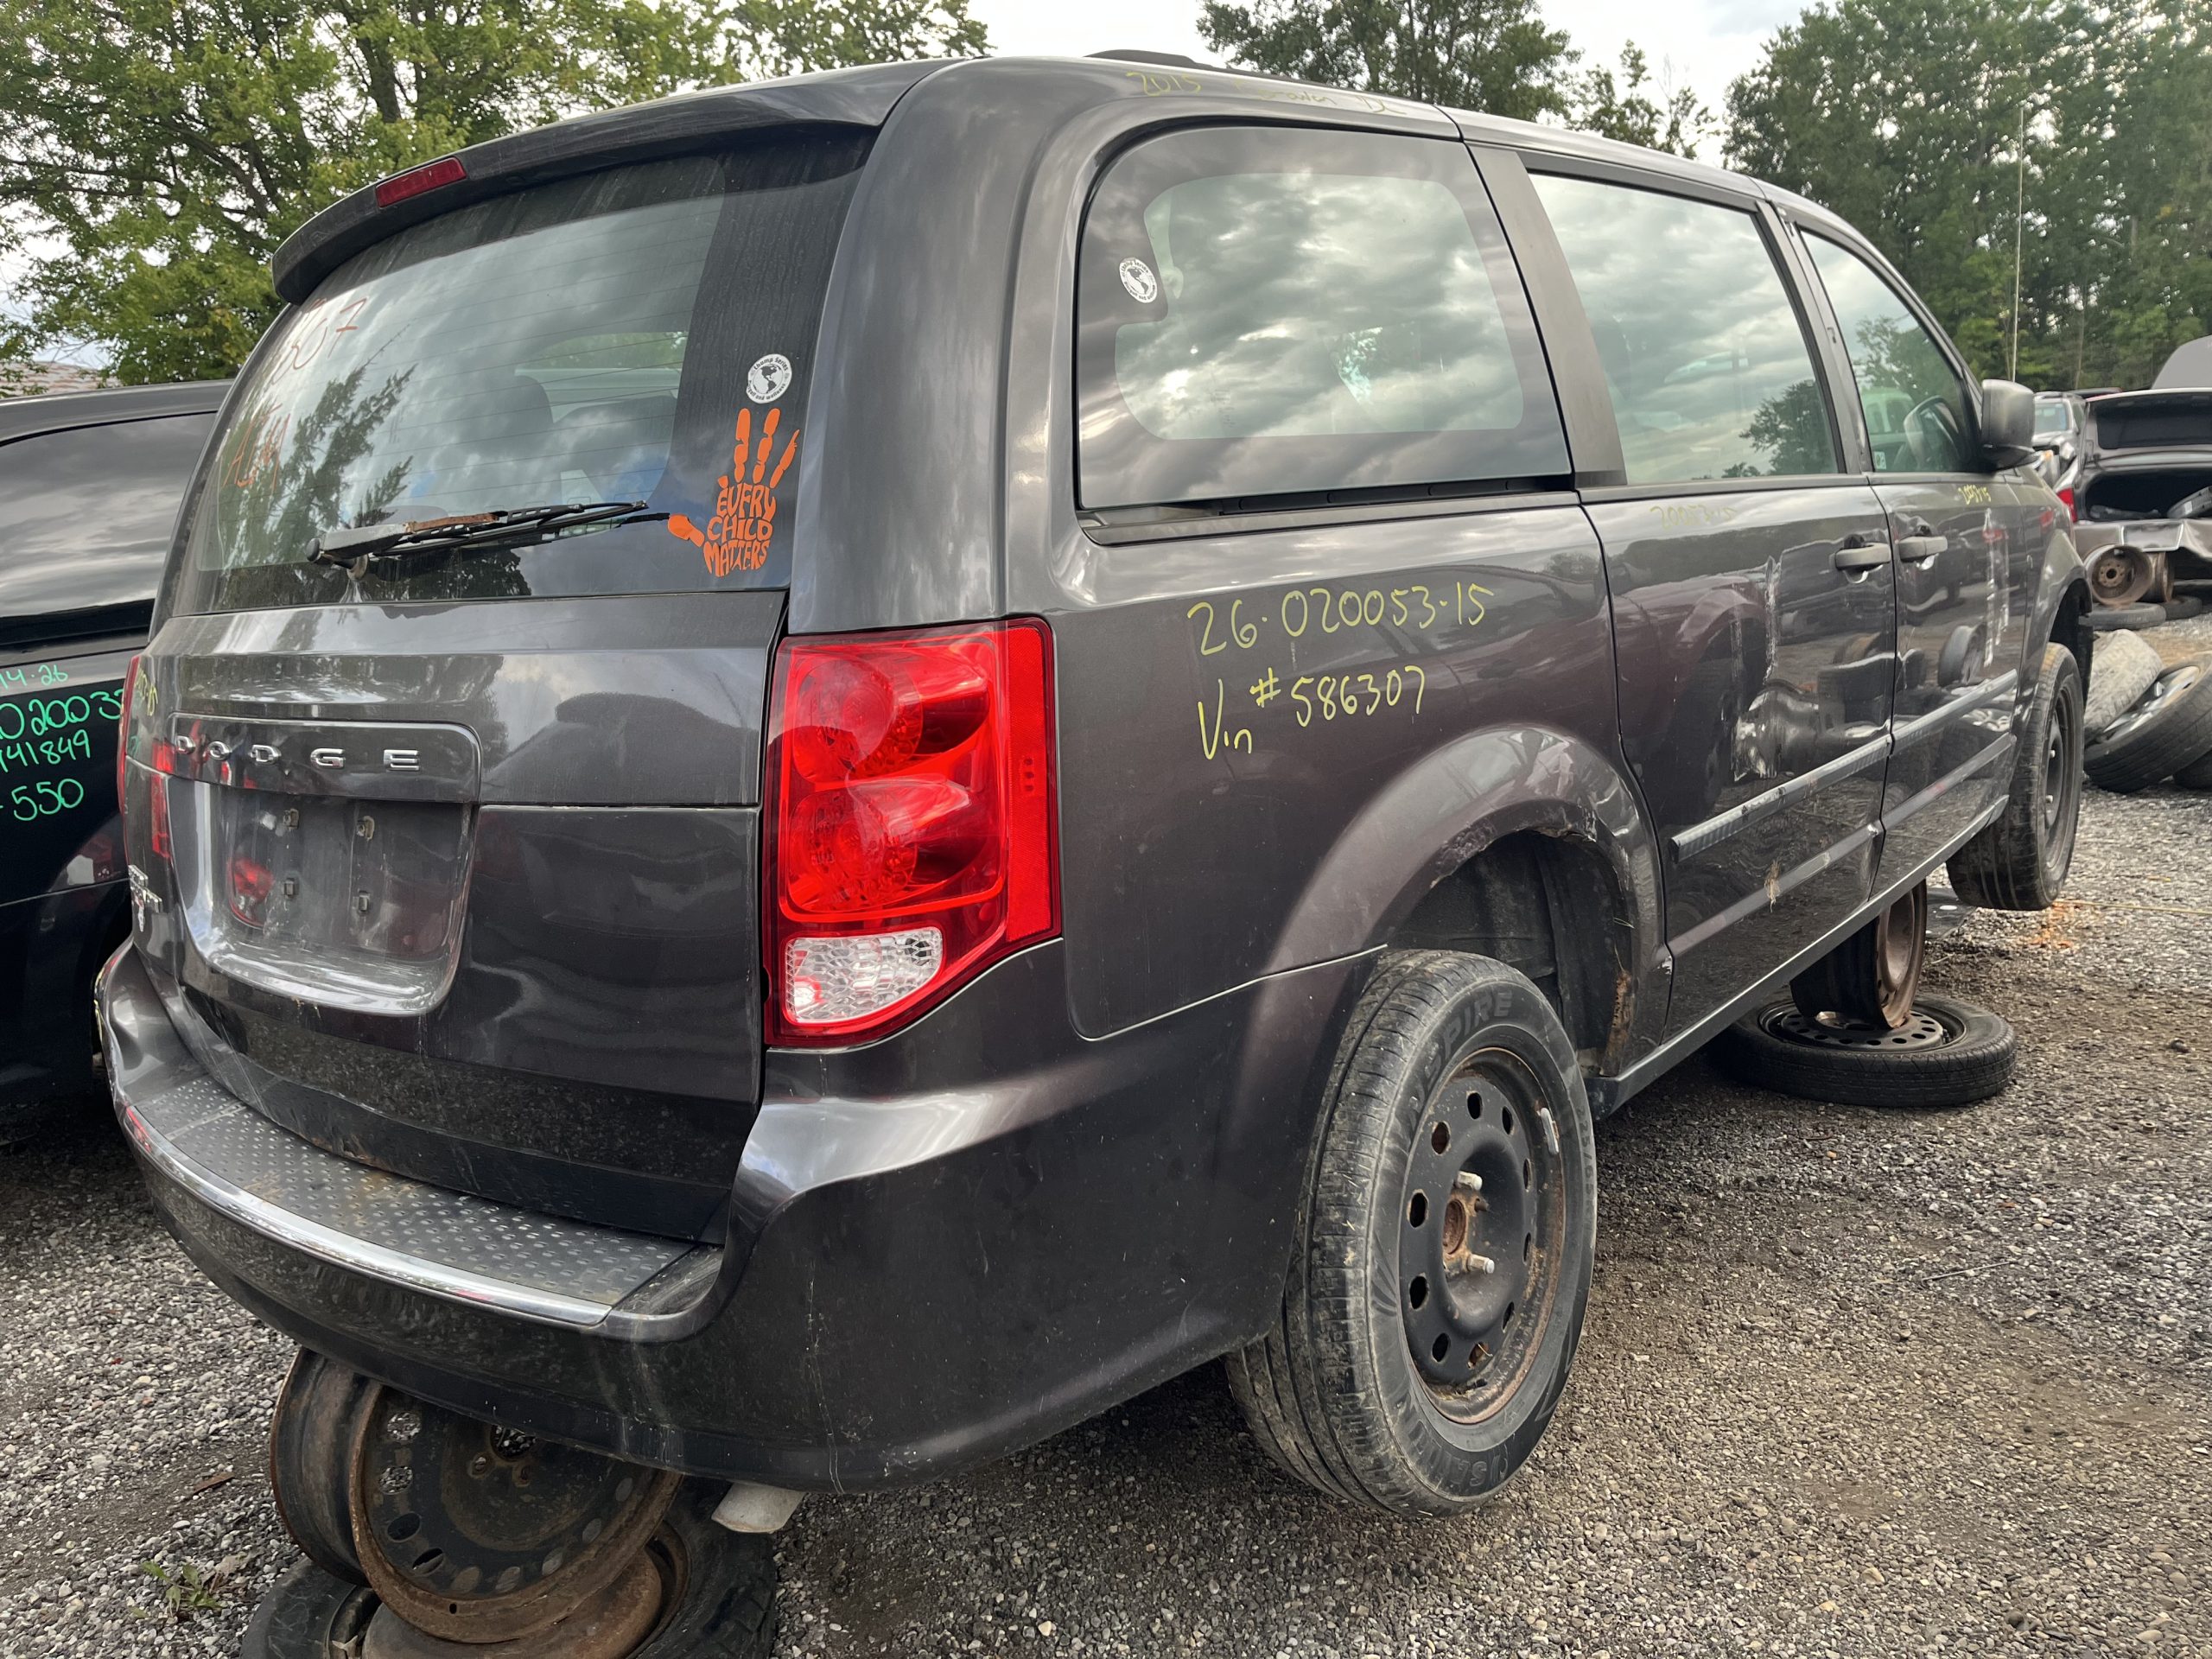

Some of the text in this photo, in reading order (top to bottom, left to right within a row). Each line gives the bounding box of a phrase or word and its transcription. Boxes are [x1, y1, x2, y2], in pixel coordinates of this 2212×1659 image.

[707, 515, 773, 543] CHILD
[703, 539, 770, 577] MATTERS
[174, 734, 421, 772] DODGE
